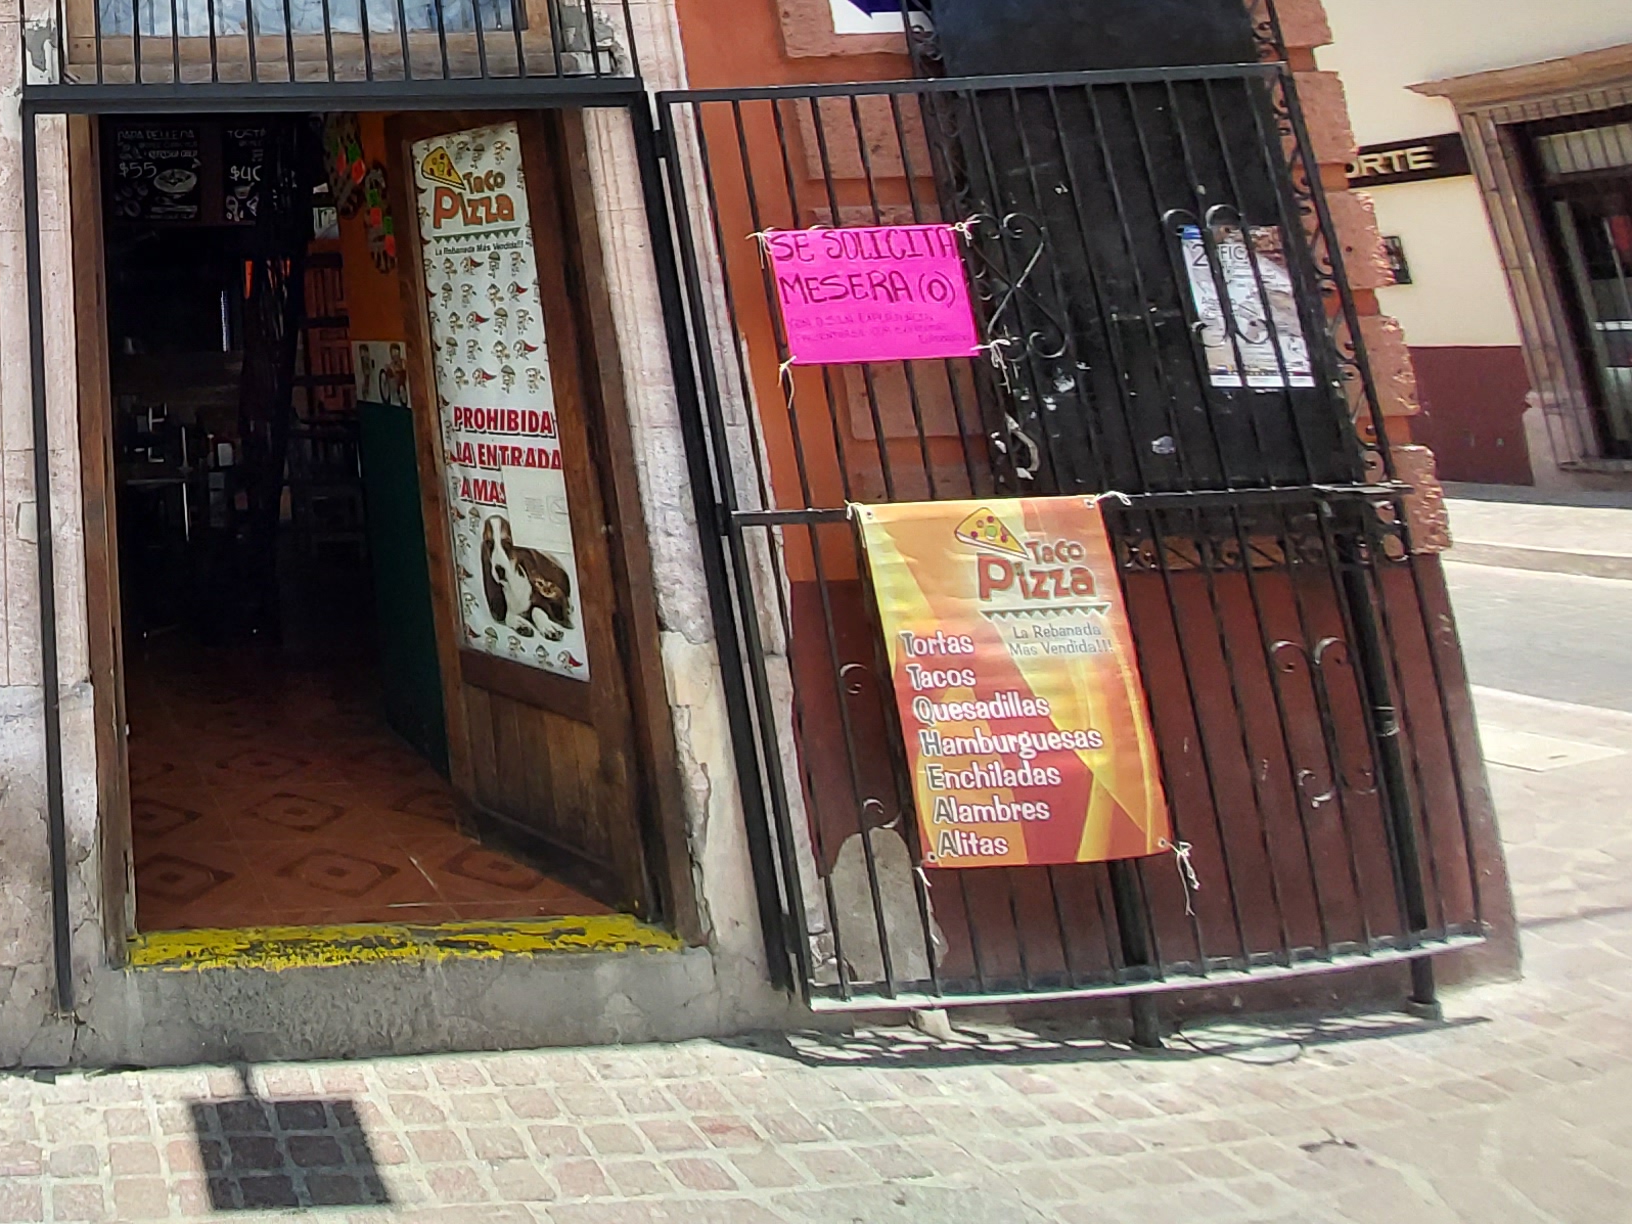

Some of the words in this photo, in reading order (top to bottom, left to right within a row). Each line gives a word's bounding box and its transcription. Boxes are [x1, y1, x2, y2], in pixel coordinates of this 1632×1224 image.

[119, 161, 158, 179] $55
[462, 168, 506, 195] Taco
[432, 186, 516, 229] Pizza
[770, 233, 815, 263] SE
[821, 227, 958, 261] SOLICITA
[453, 406, 556, 437] PROHIBIDA
[455, 441, 475, 467] LA
[477, 442, 562, 470] ENTRADA
[1026, 539, 1084, 564] Taco
[976, 552, 1097, 602] Pizza
[899, 631, 974, 658] Tortas
[1012, 626, 1029, 639] La
[1032, 622, 1102, 639] Rebanada
[907, 664, 977, 690] Tacos
[913, 691, 1051, 723] Quesadillas
[919, 727, 1104, 760] Hamburguesas
[926, 760, 1062, 790] Enchiladas
[933, 795, 1051, 824] Alambres
[937, 828, 1009, 859] Alitas
